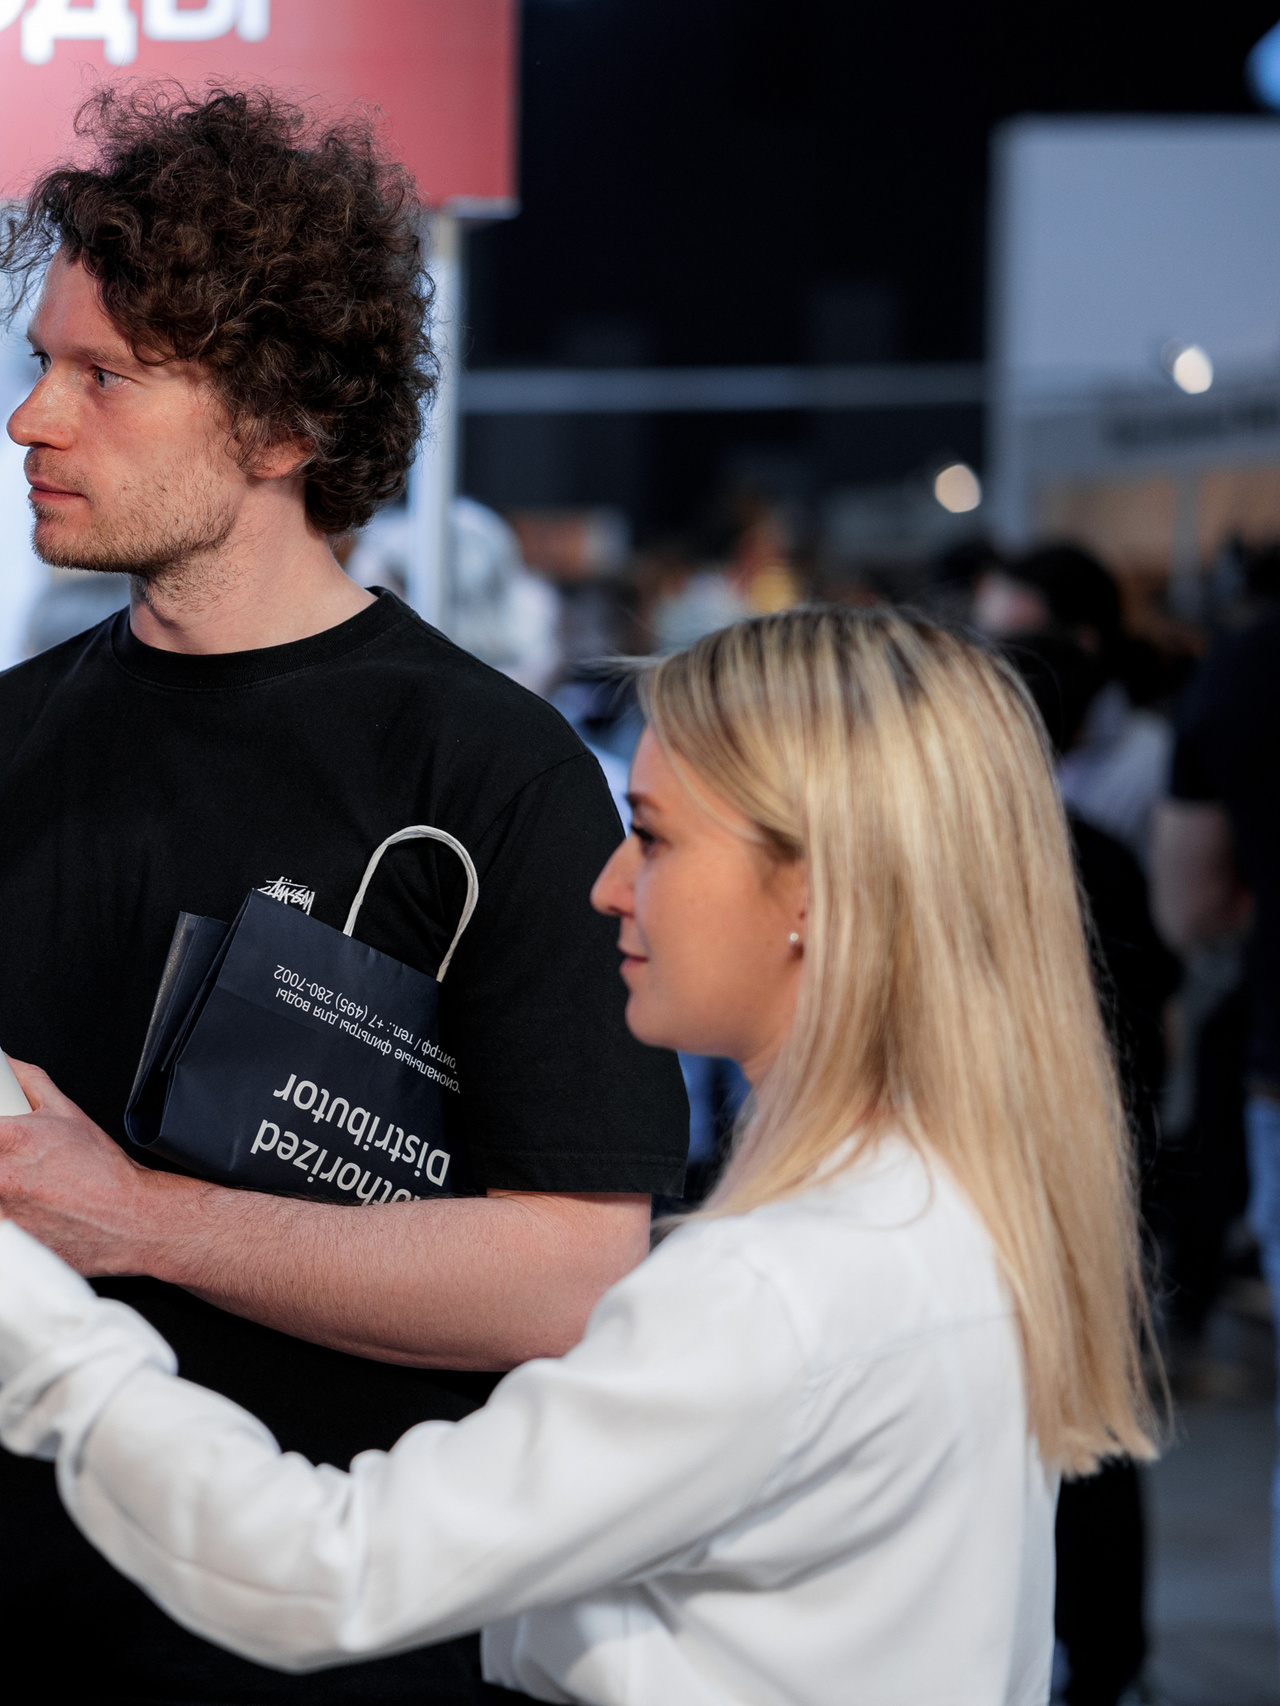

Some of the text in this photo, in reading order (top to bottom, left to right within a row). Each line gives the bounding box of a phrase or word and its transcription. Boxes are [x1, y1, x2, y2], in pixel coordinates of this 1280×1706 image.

[273, 964, 334, 1005] 280-7002
[335, 993, 368, 1022] (495)
[368, 1014, 384, 1029] +7
[275, 987, 461, 1094] сиональные фильтры для воды
[386, 1022, 413, 1044] тел.:
[421, 1040, 457, 1075] рит.рф
[273, 1073, 451, 1187] Distributor
[250, 1119, 421, 1207] uthorized
